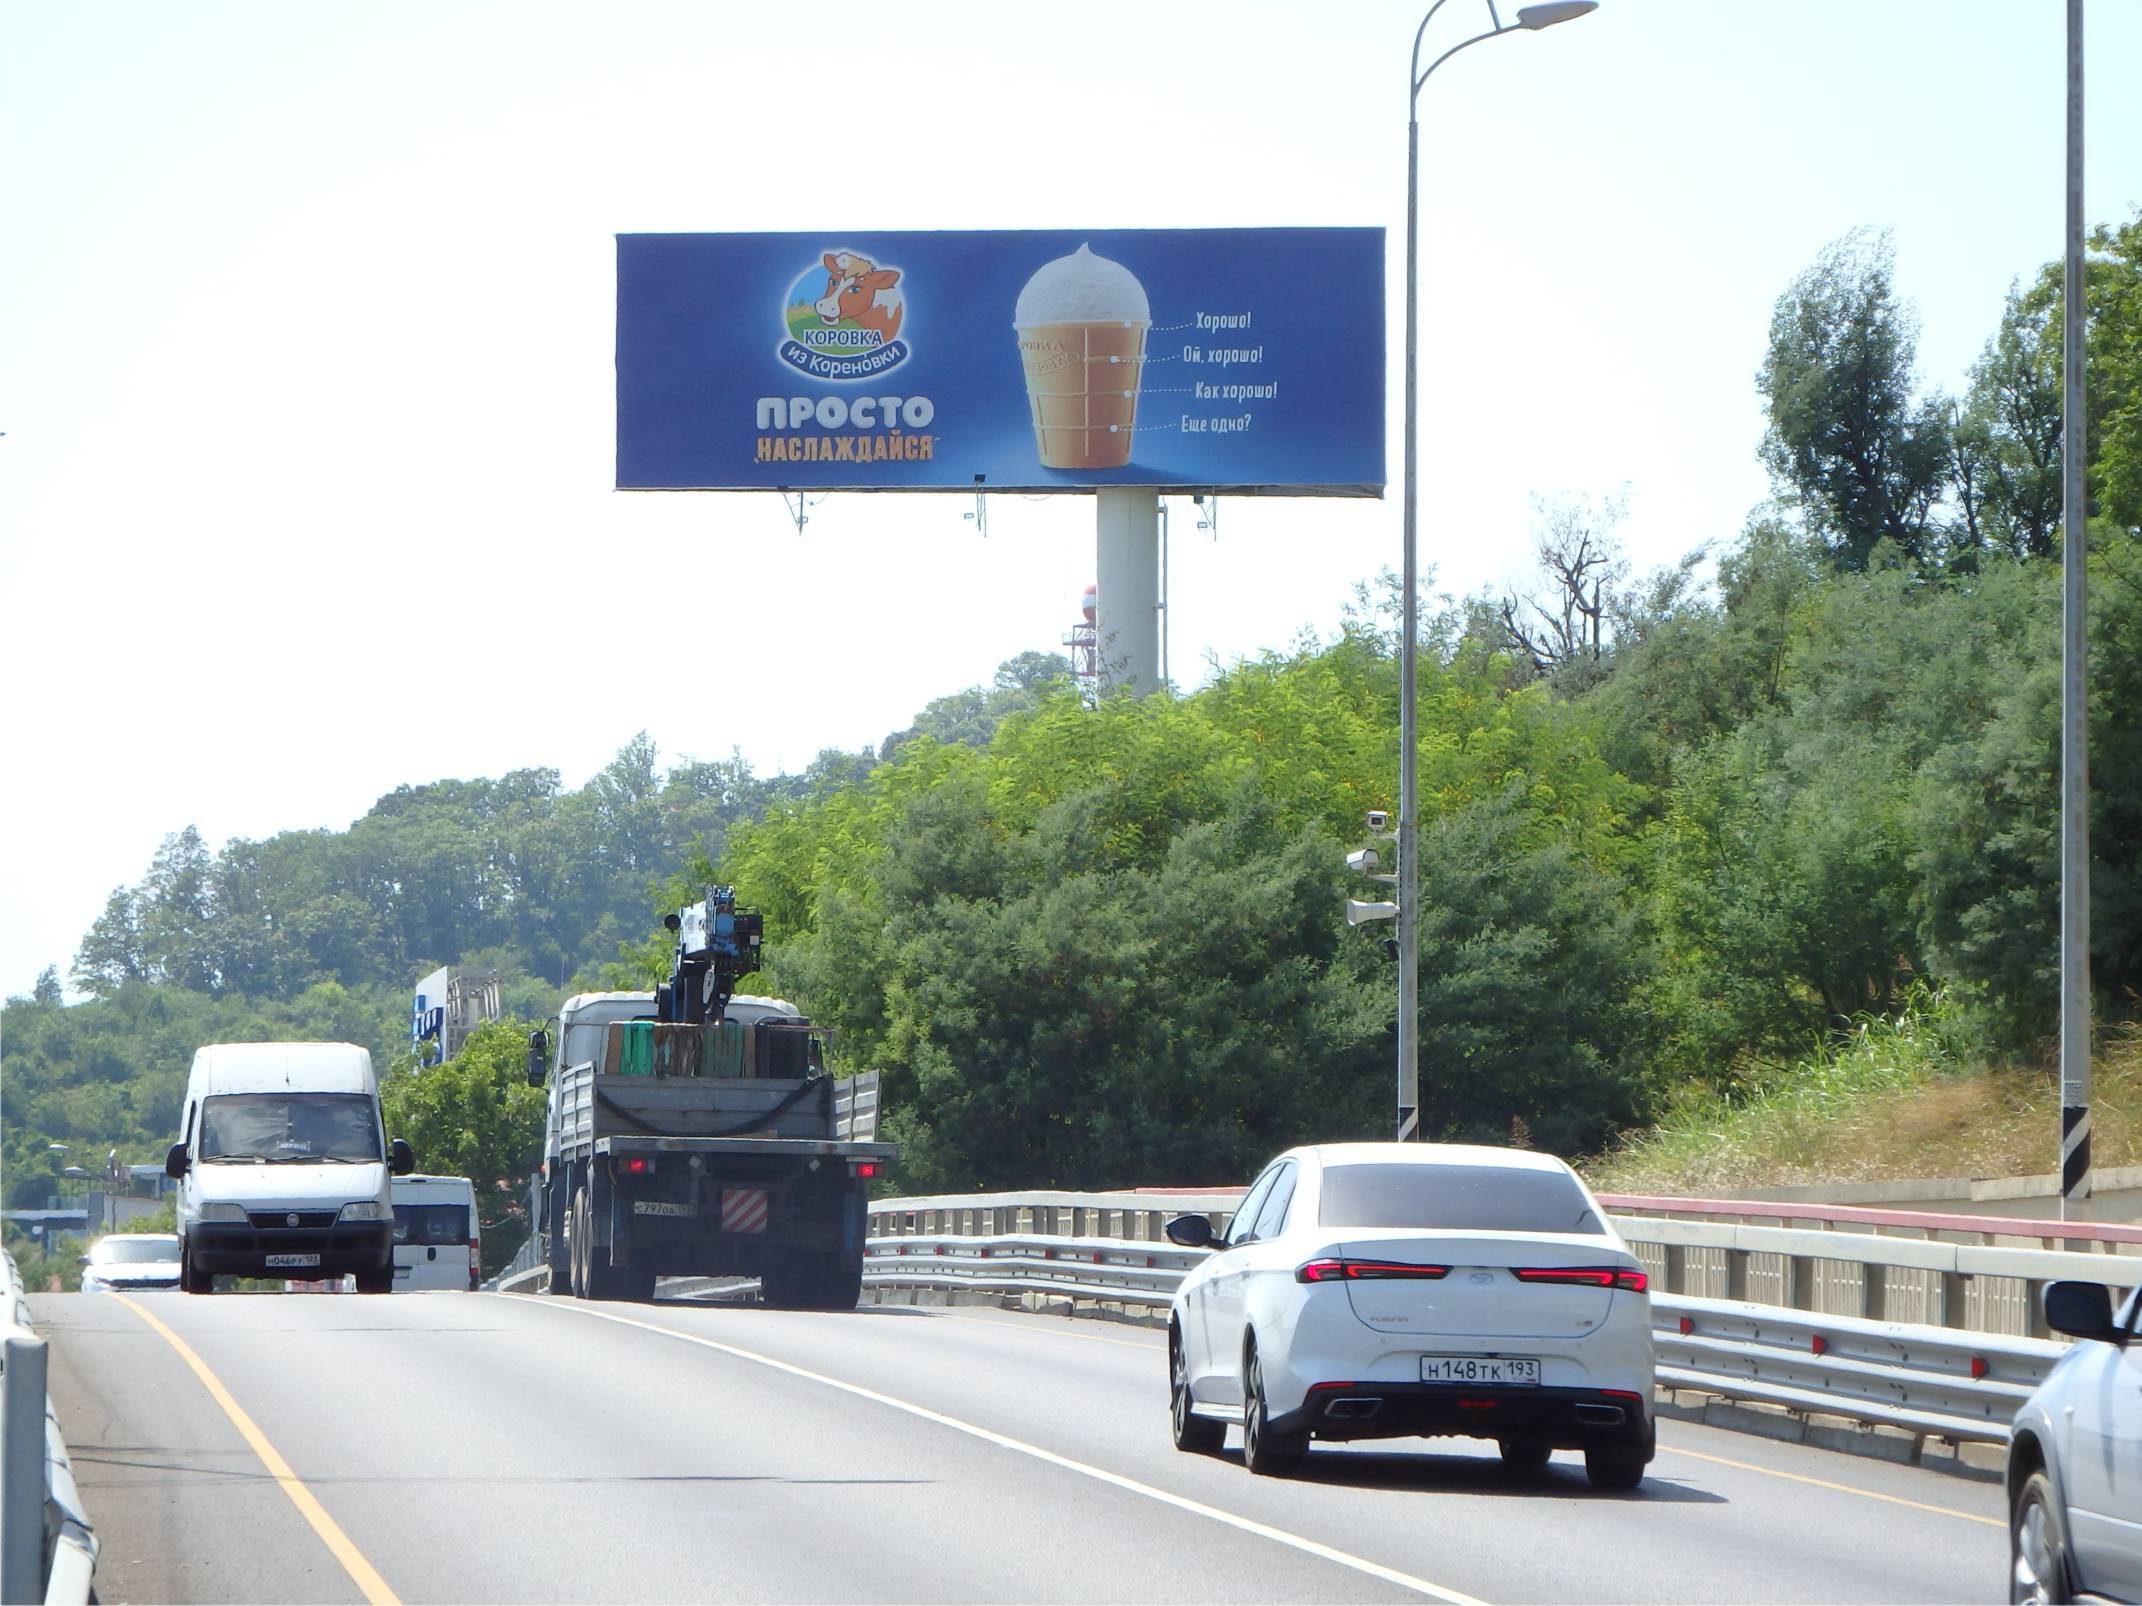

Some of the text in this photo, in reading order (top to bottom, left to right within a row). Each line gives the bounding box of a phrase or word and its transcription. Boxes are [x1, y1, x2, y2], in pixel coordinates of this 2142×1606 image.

[1196, 311, 1252, 334] Хорошо!
[805, 330, 883, 346] КОРОВКА
[787, 346, 807, 364] из
[1183, 345, 1264, 368] Ой, хорошо!
[1195, 381, 1278, 404] Как хорошо!
[756, 395, 935, 430] ПРОСТО
[1181, 413, 1252, 434] Еще одно?
[756, 429, 934, 463] НАСЛАЖДАЙСЯ
[1506, 1361, 1535, 1377] 193
